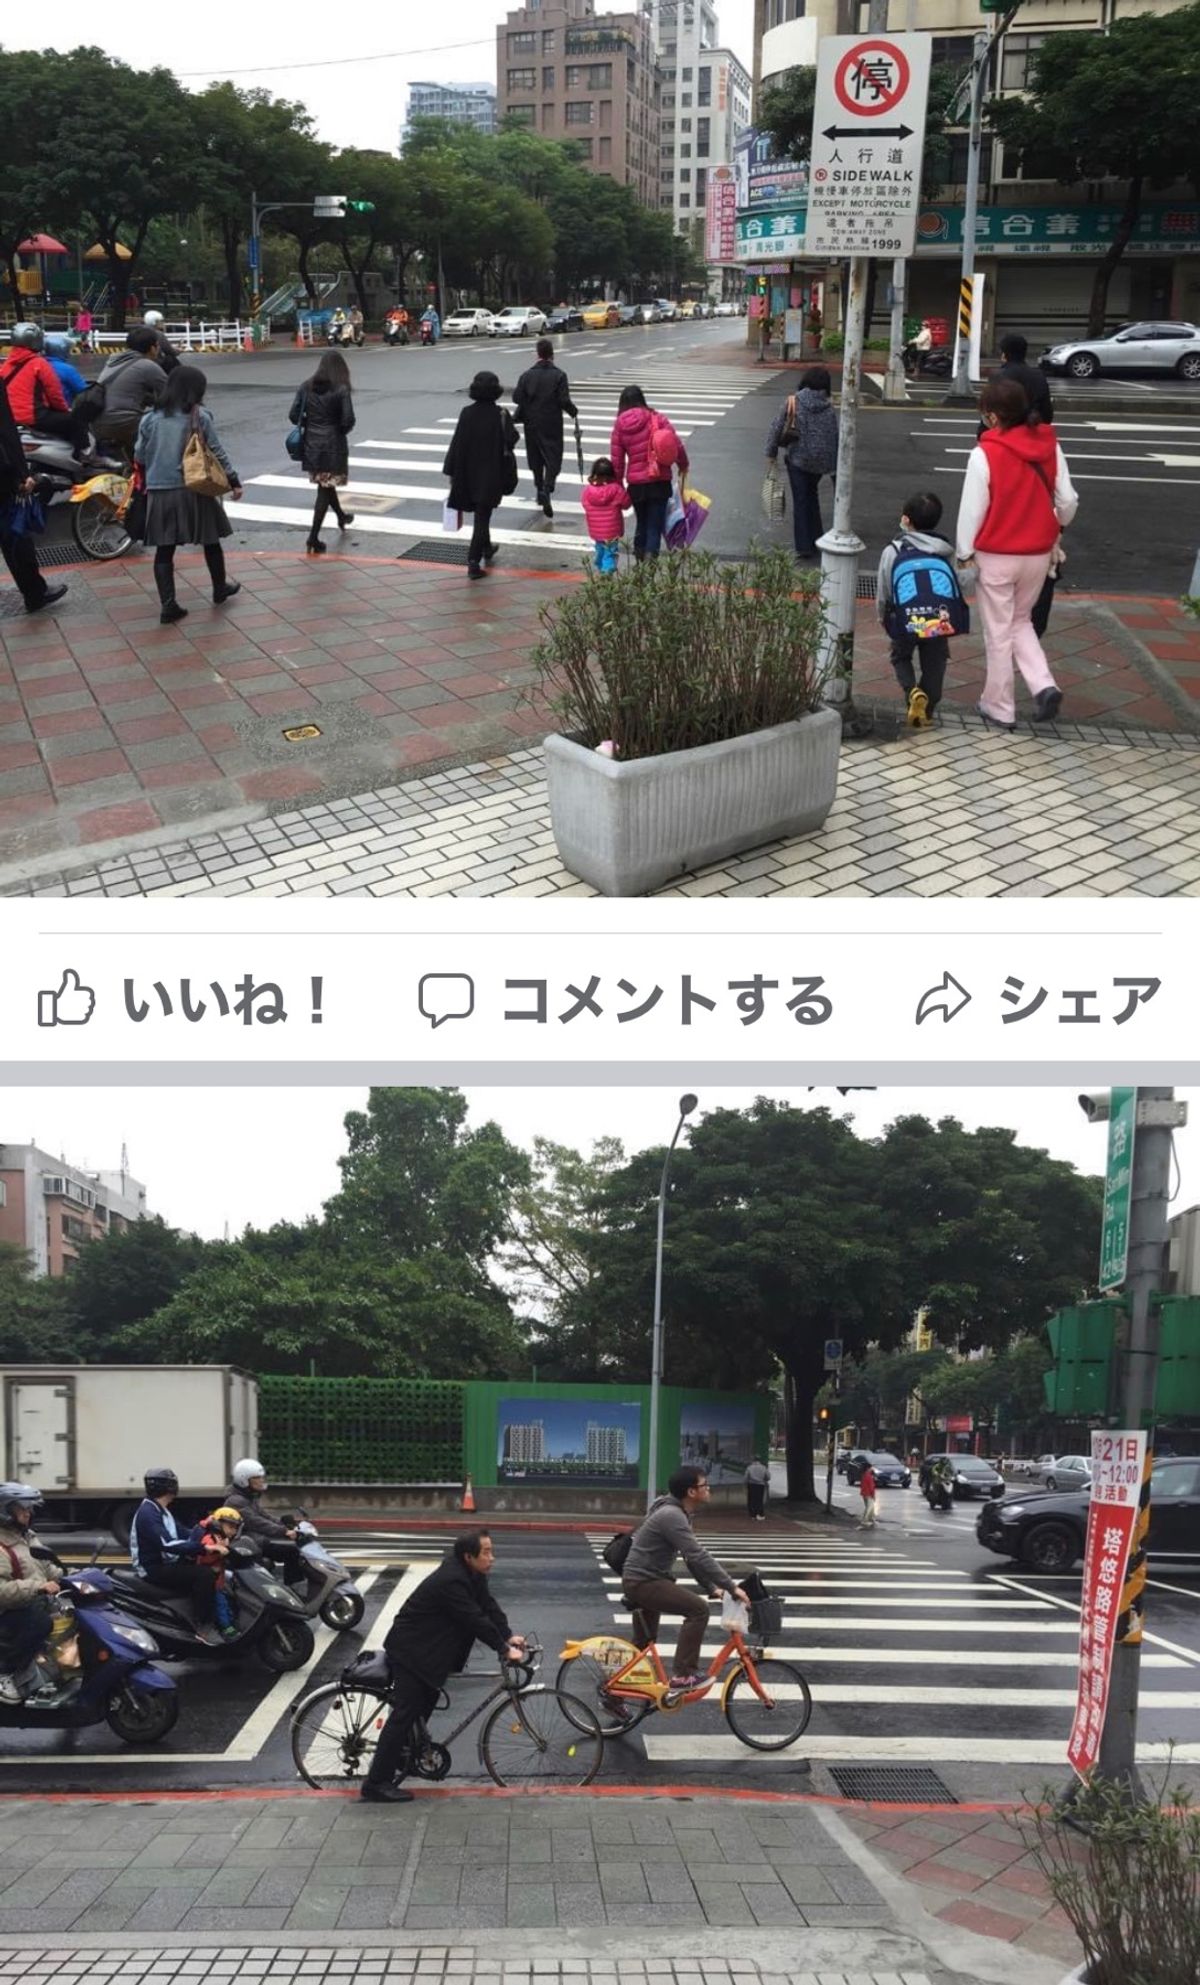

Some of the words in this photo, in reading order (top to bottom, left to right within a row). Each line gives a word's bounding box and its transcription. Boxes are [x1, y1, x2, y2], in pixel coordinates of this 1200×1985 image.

[851, 58, 893, 100] 停
[828, 148, 904, 164] 人行道
[832, 170, 913, 181] SIDEWALK
[812, 200, 845, 208] EXCEPT
[850, 200, 911, 209] MOTORCYCLE
[872, 239, 902, 250] 1999
